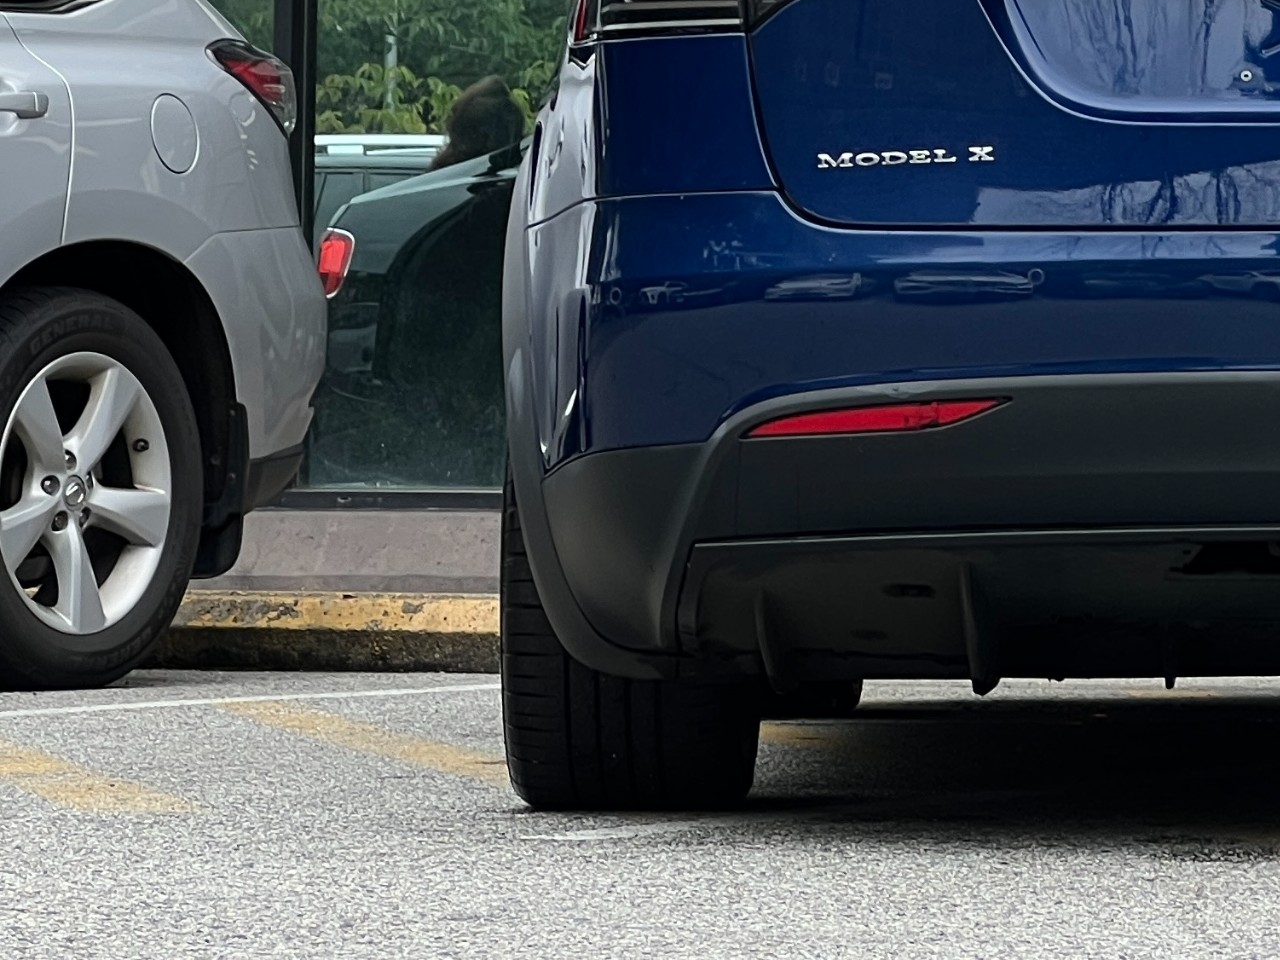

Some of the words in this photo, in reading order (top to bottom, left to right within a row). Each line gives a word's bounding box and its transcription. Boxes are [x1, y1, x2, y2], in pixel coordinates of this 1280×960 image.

[816, 149, 957, 169] MODEL
[967, 145, 995, 162] X
[29, 313, 114, 355] GENERAL
